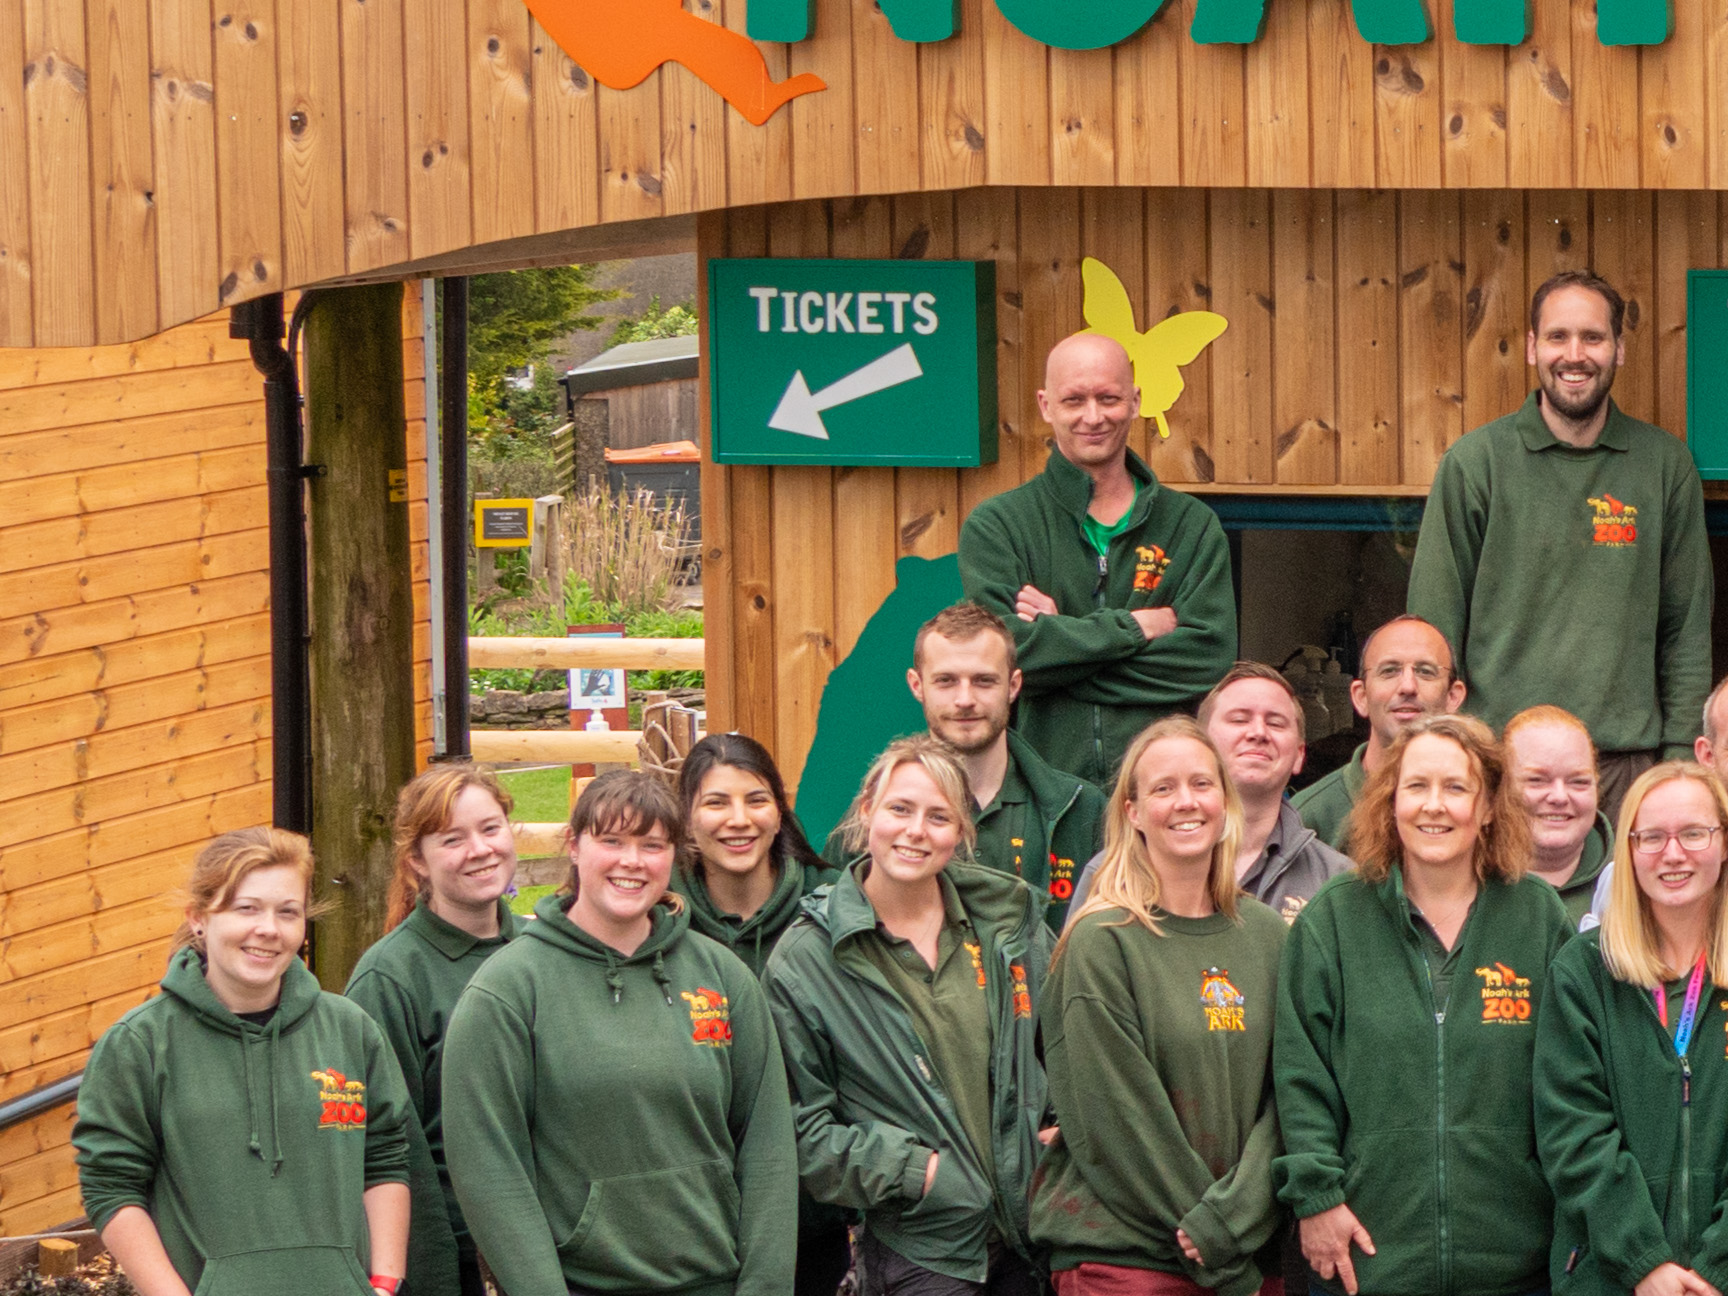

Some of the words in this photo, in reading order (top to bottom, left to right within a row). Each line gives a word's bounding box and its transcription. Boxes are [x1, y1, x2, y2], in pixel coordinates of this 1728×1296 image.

[749, 287, 939, 335] TICKETS
[1593, 524, 1637, 543] ZOO
[1482, 988, 1513, 999] Noah's
[1482, 998, 1530, 1020] ZOO
[1209, 1015, 1246, 1032] ARK
[320, 1102, 366, 1124] ZOO
